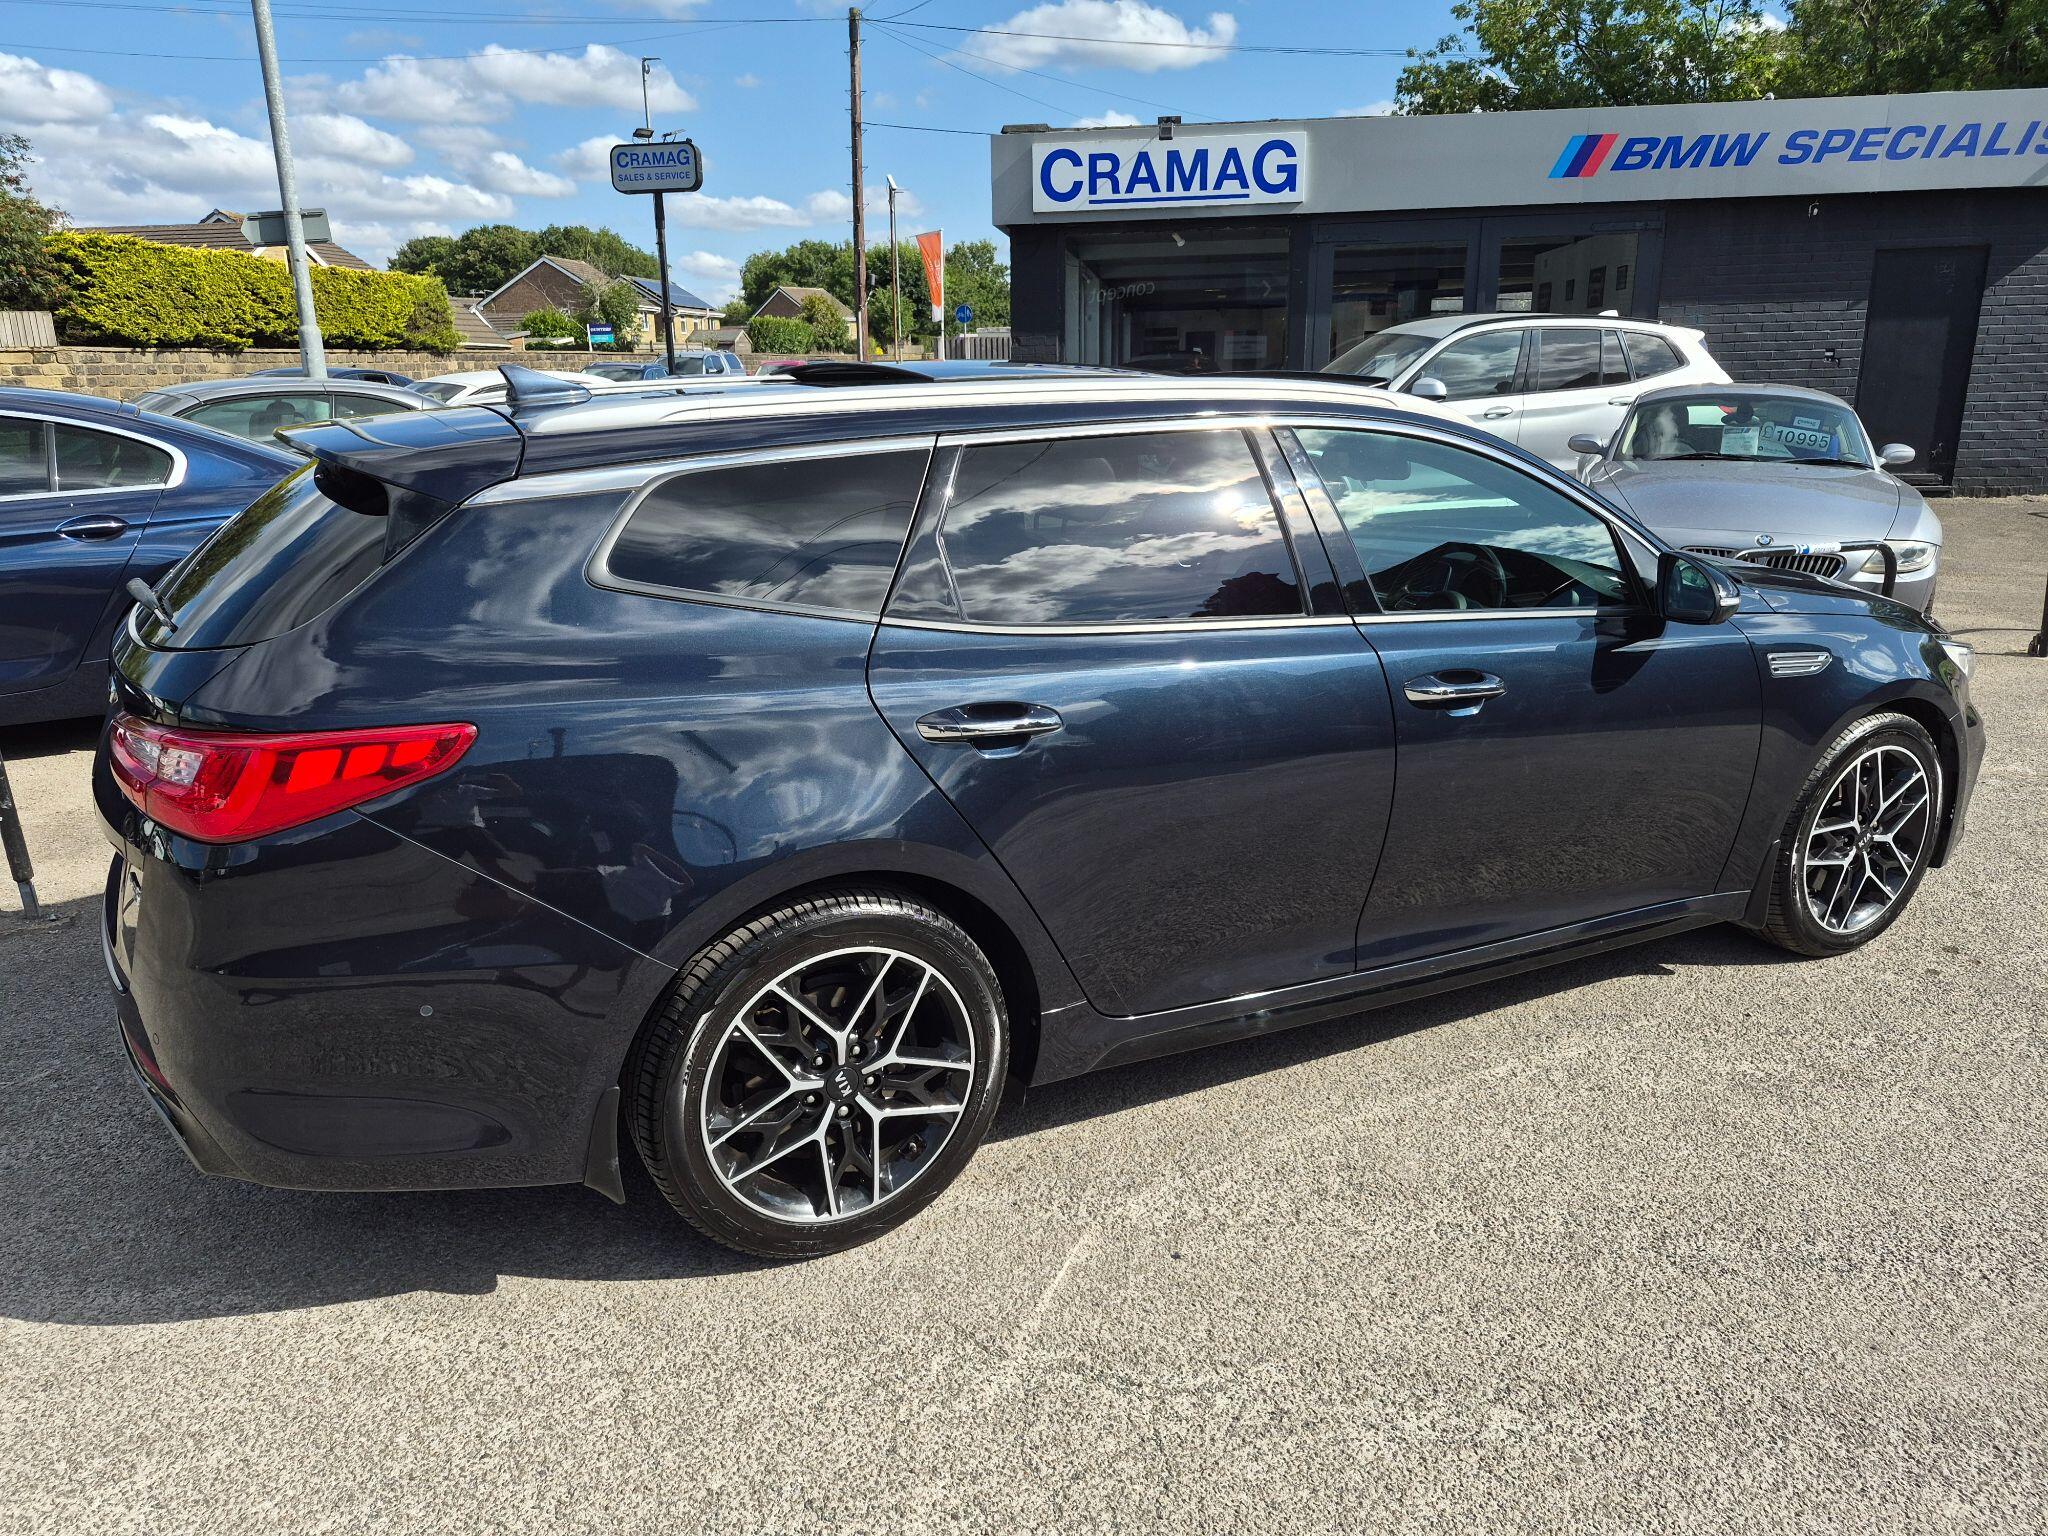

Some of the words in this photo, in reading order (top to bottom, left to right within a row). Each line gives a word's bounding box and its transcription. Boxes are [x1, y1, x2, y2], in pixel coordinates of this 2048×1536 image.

[616, 148, 690, 168] CRAMAG
[1610, 132, 1771, 171] BMW
[618, 173, 645, 182] SALES
[655, 171, 691, 181] SERVICE
[1040, 139, 1298, 203] CRAMAG
[834, 1070, 853, 1098] KIA
